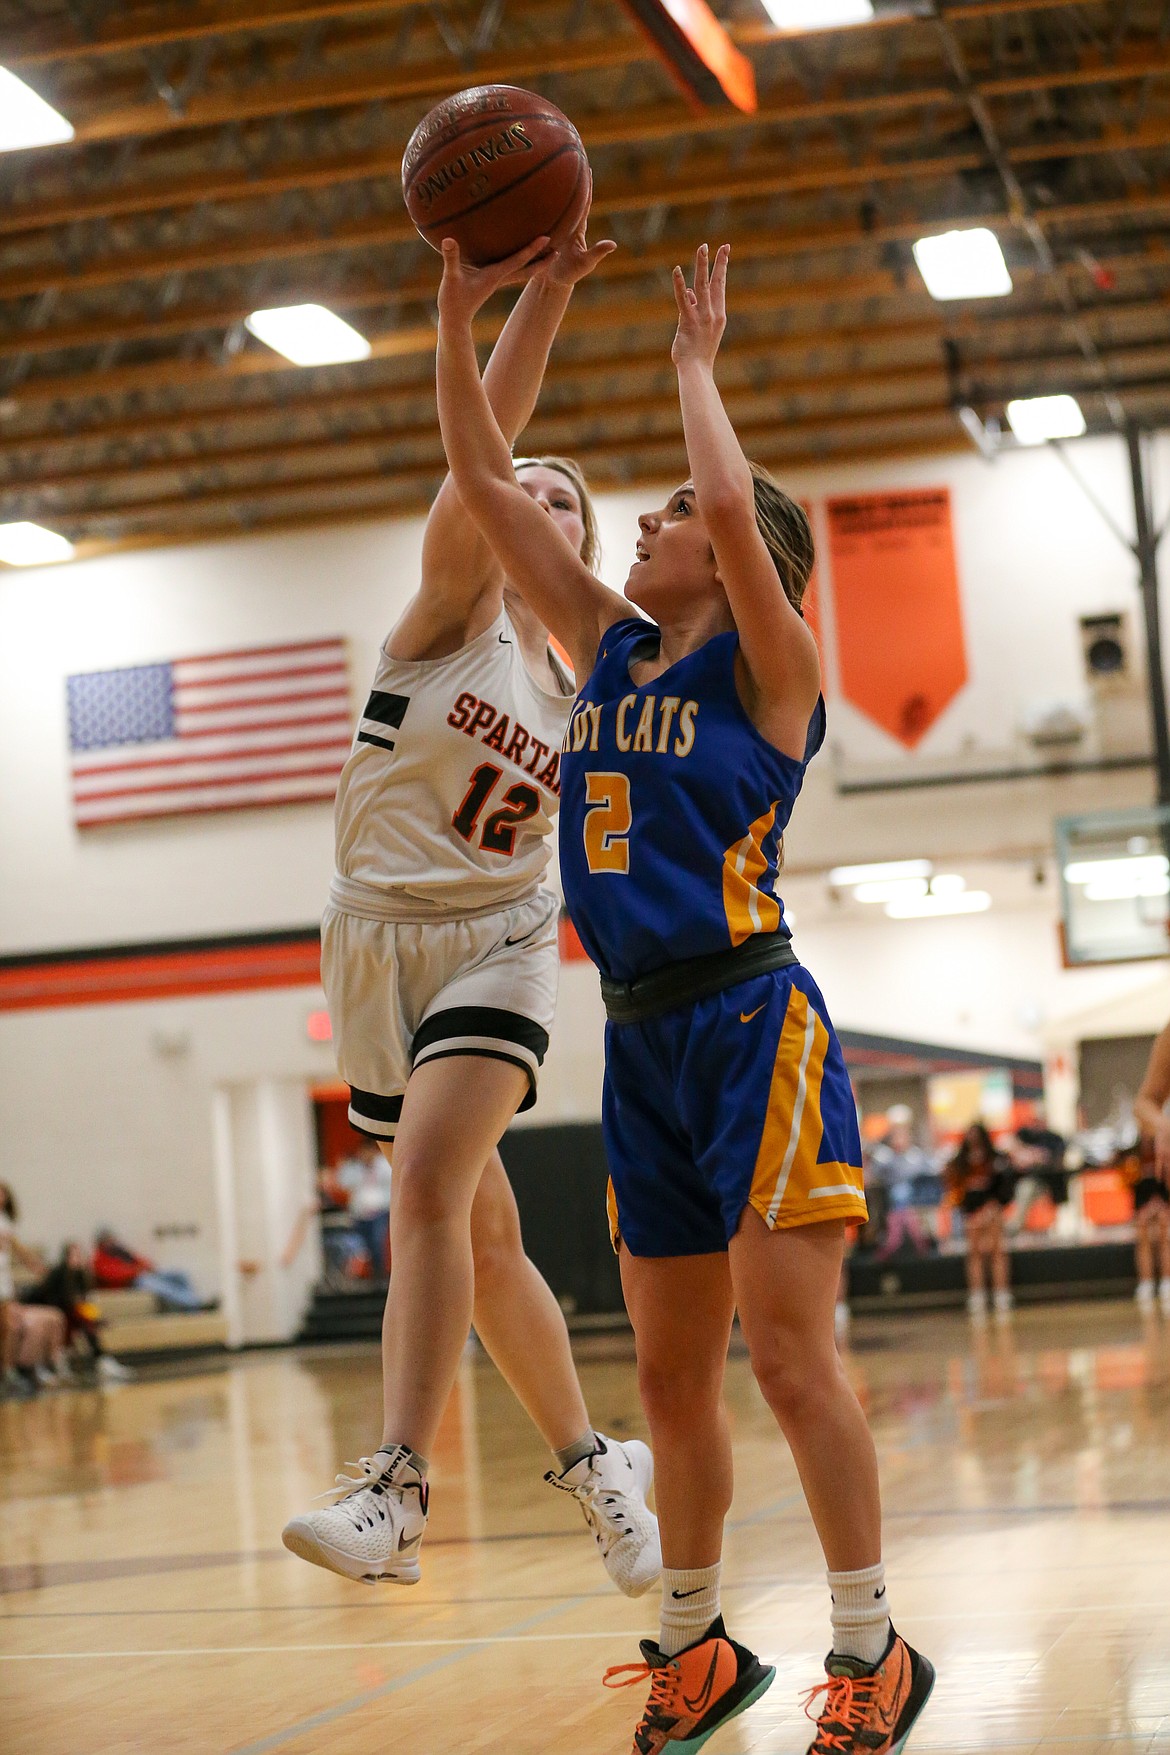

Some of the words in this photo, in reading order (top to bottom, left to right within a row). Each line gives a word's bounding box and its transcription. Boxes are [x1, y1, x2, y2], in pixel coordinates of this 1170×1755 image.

[416, 121, 533, 207] SPALDING
[447, 692, 560, 797] SPARTA
[616, 694, 699, 757] CATS
[451, 761, 541, 856] 12
[583, 771, 633, 874] 2
